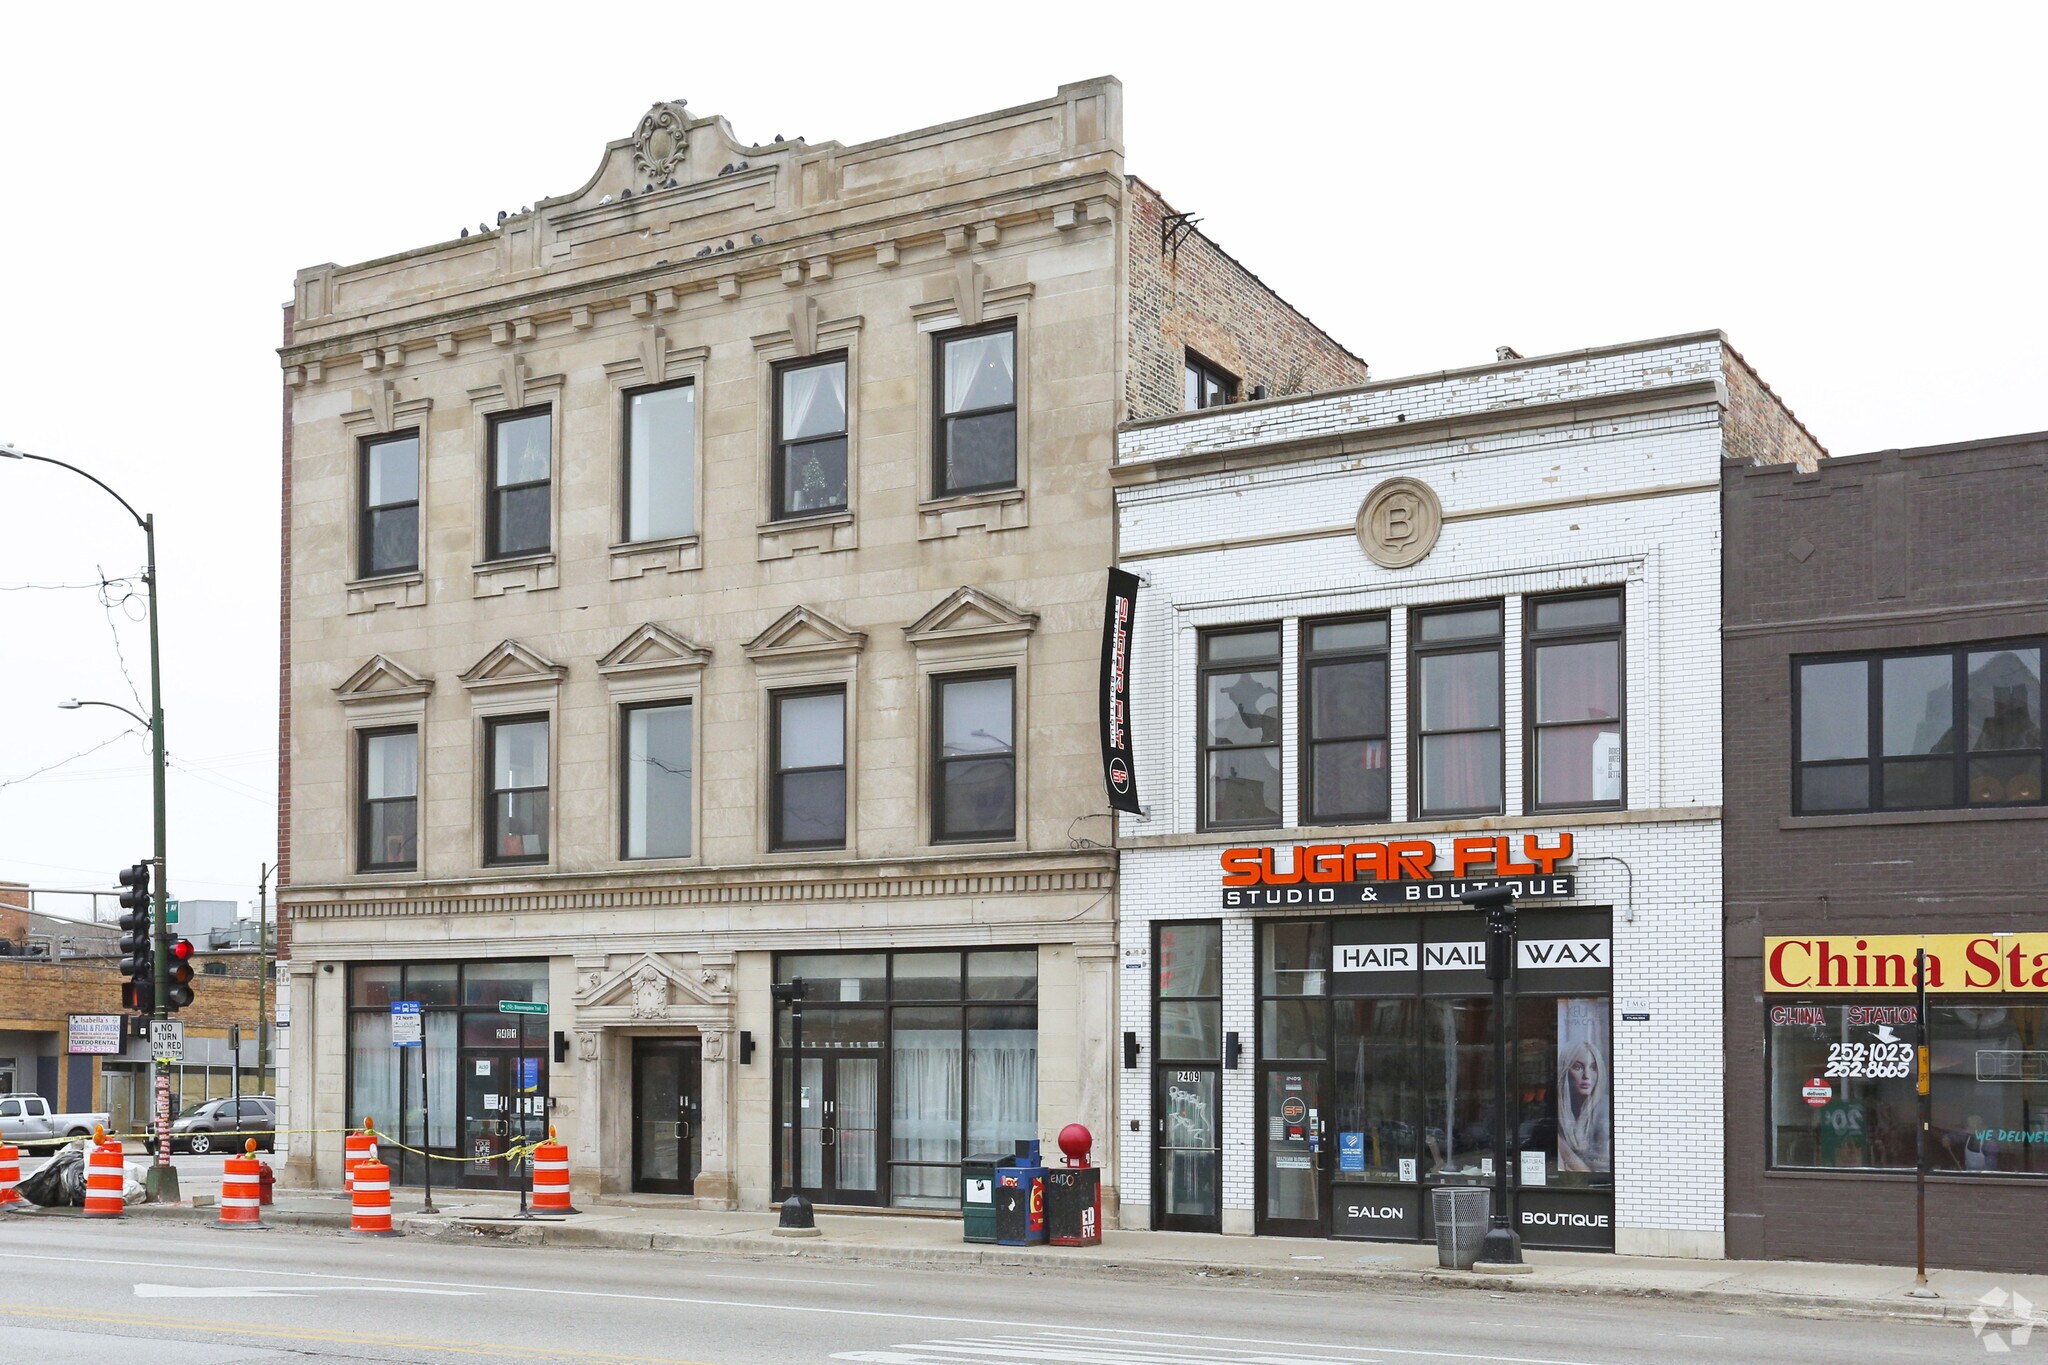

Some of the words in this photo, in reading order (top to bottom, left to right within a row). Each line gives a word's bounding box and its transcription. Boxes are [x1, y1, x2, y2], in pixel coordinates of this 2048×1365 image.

[1385, 506, 1414, 540] B
[1116, 597, 1129, 693] SUGAR
[1220, 840, 1436, 886] SUGAR
[1454, 832, 1573, 878] FLY
[1226, 888, 1335, 906] STUDIO
[1361, 887, 1378, 902] &
[1343, 948, 1409, 967] HAIR
[1525, 943, 1601, 963] WAX
[1769, 939, 1944, 988] China
[1770, 1006, 1825, 1025] CHINA
[70, 1024, 89, 1032] BRIDAL
[95, 1024, 120, 1032] FLOWERS
[161, 1024, 173, 1032] NO
[496, 1028, 517, 1039] 2401
[153, 1041, 163, 1049] ON
[167, 1041, 181, 1049] RED
[1178, 1071, 1200, 1082] 2409
[1975, 1129, 1994, 1141] WE
[1050, 1173, 1074, 1187] ENDO
[1348, 1206, 1403, 1219] SALON
[1522, 1212, 1609, 1227] BOUTIQUE
[1082, 1225, 1095, 1238] EYE
